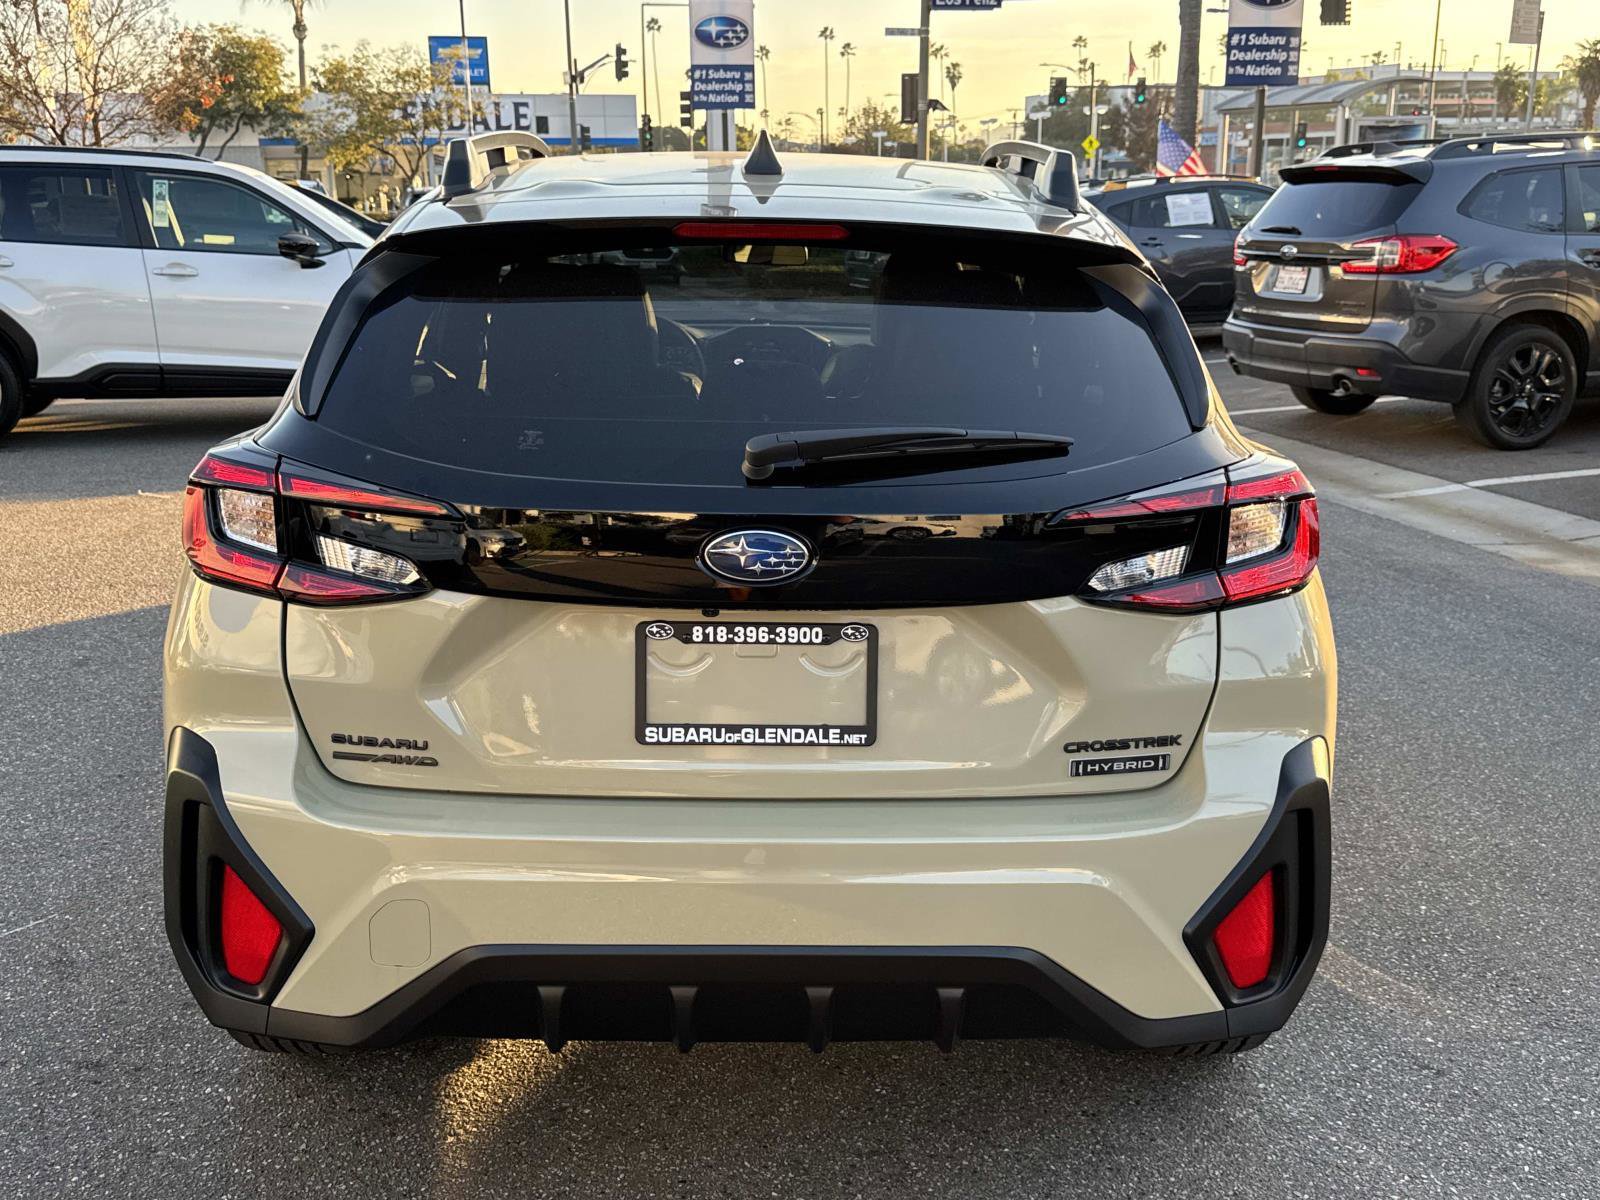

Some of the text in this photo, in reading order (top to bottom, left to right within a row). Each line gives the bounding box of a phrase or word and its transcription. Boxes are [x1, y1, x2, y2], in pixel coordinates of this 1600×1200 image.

[1230, 33, 1246, 46] #1
[1248, 33, 1286, 46] Subaru
[1229, 48, 1288, 63] Dealership
[708, 69, 741, 79] Subaru
[1245, 64, 1282, 76] Nation
[694, 81, 744, 93] Dealership
[708, 92, 740, 103] Nation
[691, 625, 823, 644] 818-396-3900
[330, 733, 429, 751] SUBARU
[1063, 734, 1183, 754] CROSSTREK
[371, 753, 439, 767] AWD
[1087, 759, 1155, 772] HYBRID
